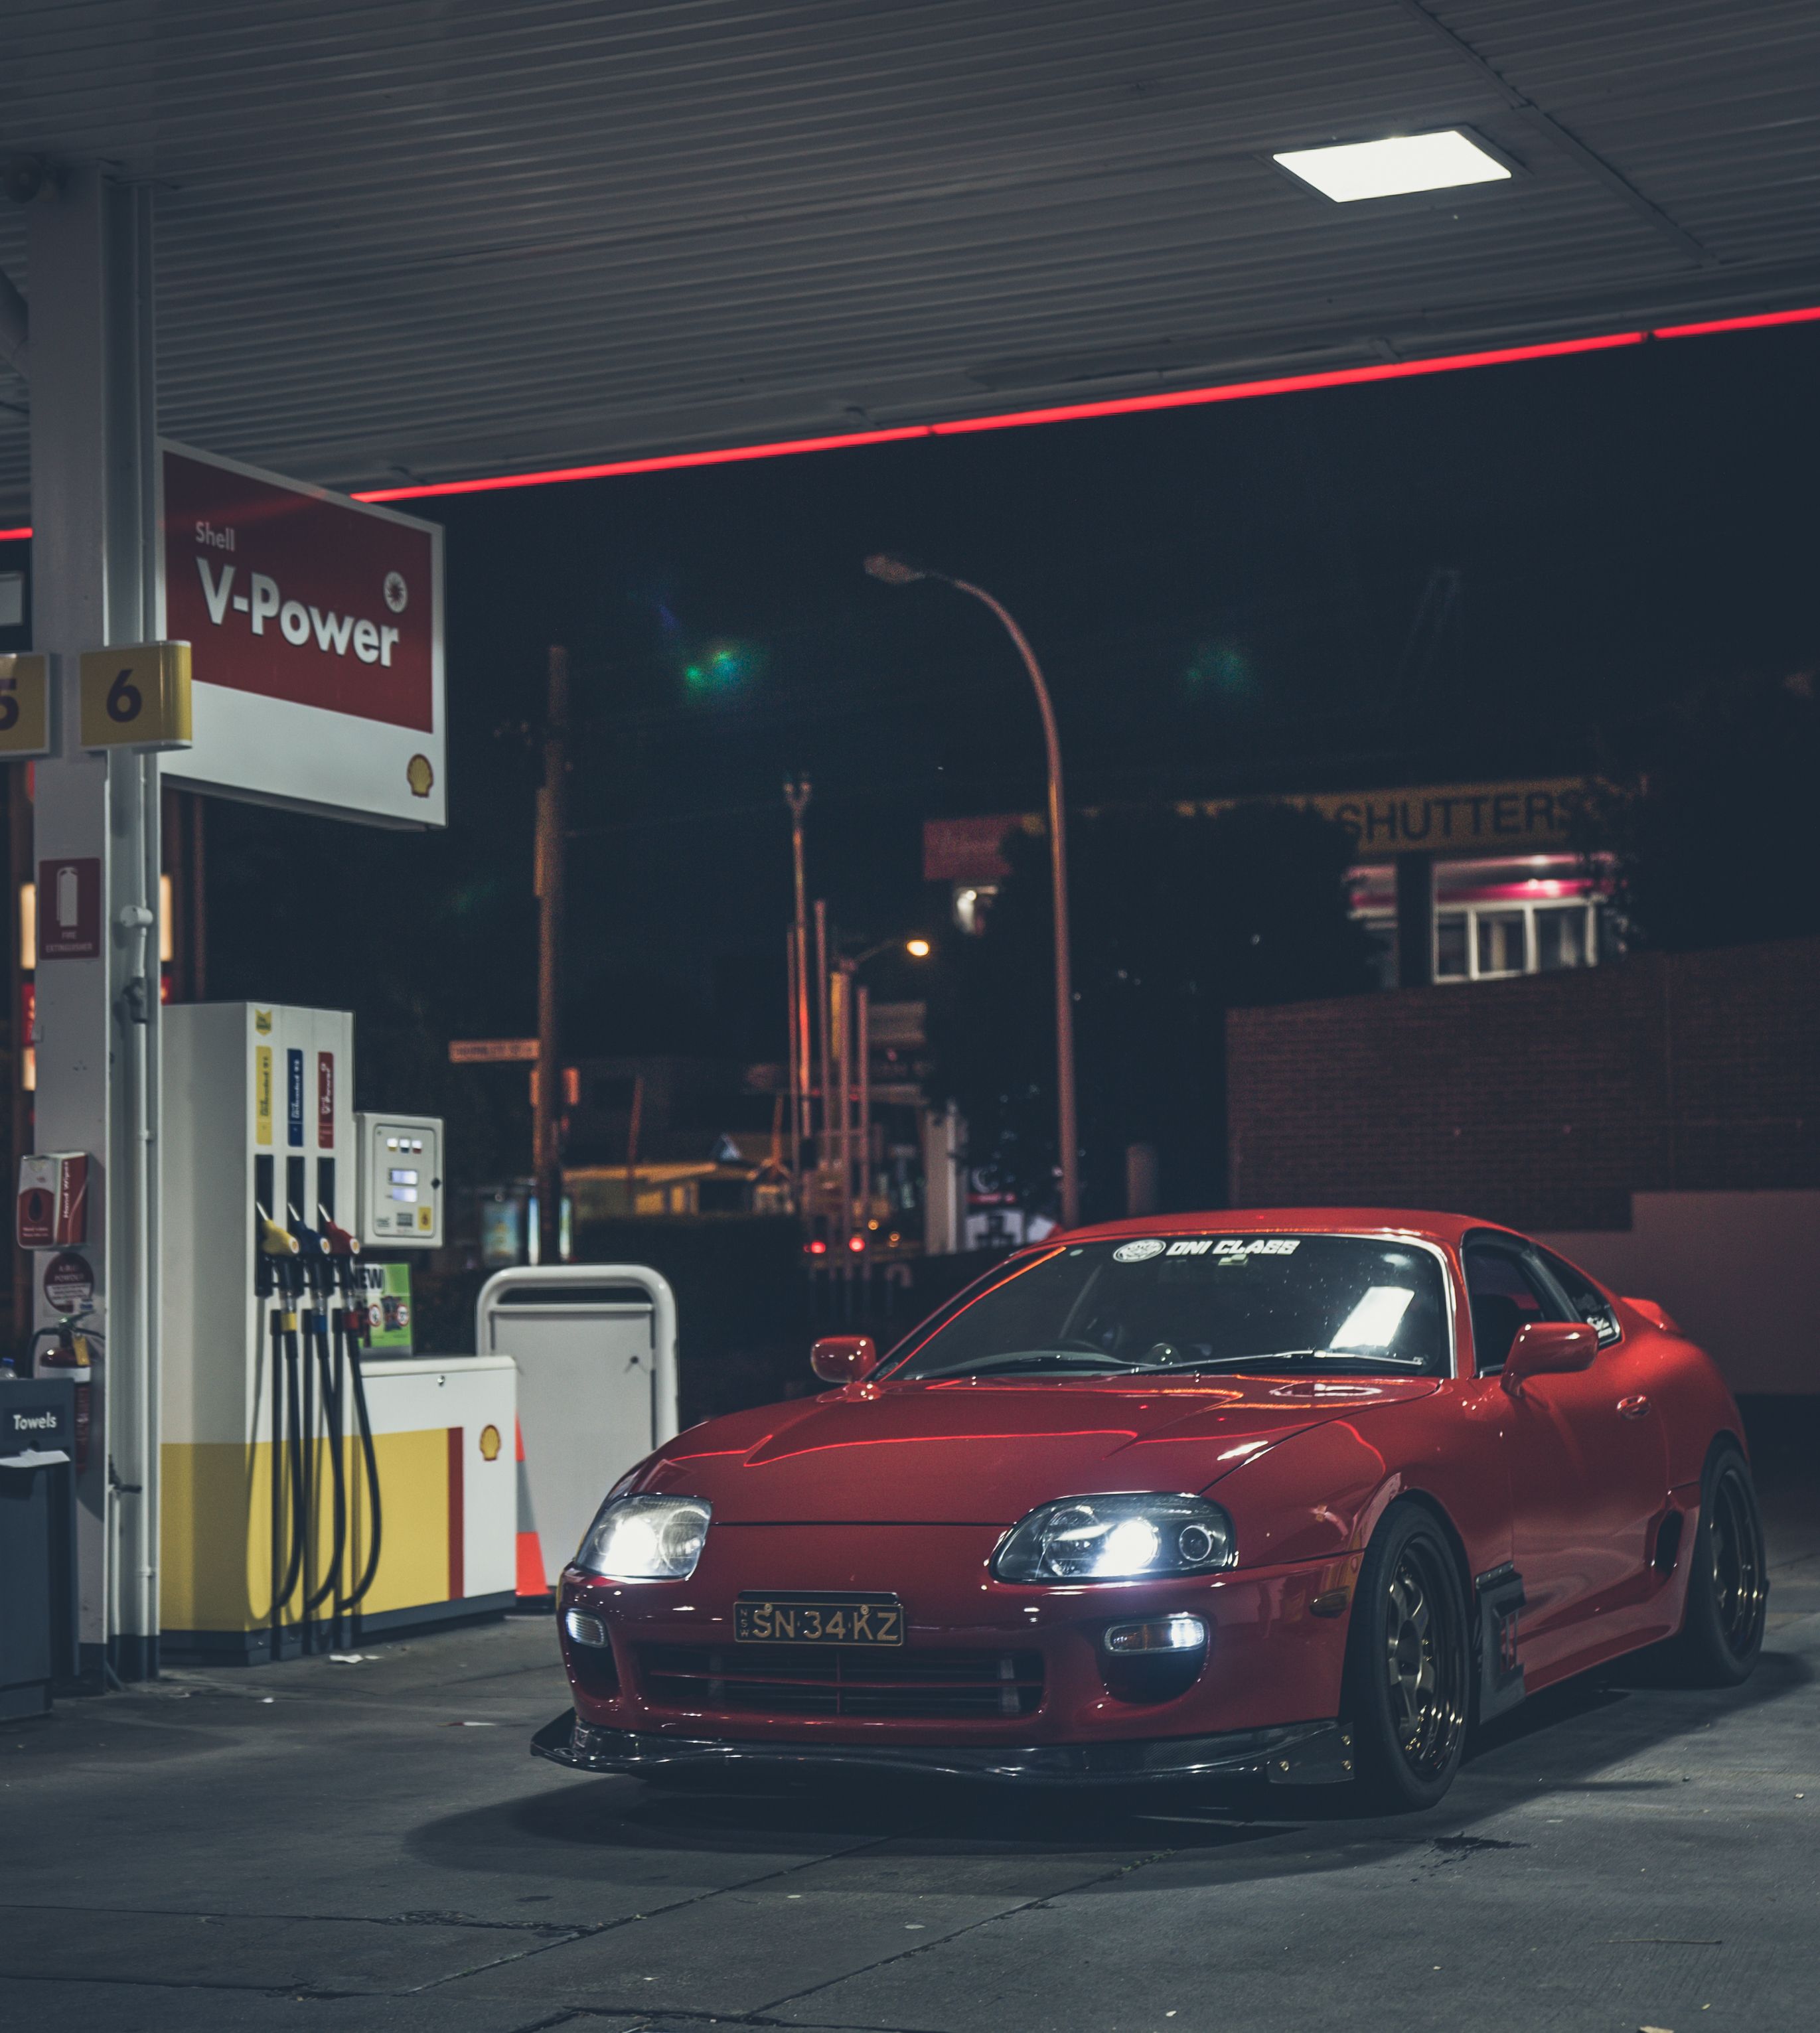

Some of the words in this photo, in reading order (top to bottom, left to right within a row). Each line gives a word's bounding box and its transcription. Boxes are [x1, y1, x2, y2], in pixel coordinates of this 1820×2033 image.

[196, 521, 235, 552] Shell
[196, 556, 400, 668] V-Power
[106, 669, 142, 723] 6
[1336, 792, 1574, 841] SHUTTERS
[1166, 1241, 1213, 1256] ONI
[1213, 1240, 1301, 1255] CLASS
[13, 1411, 57, 1430] Towels
